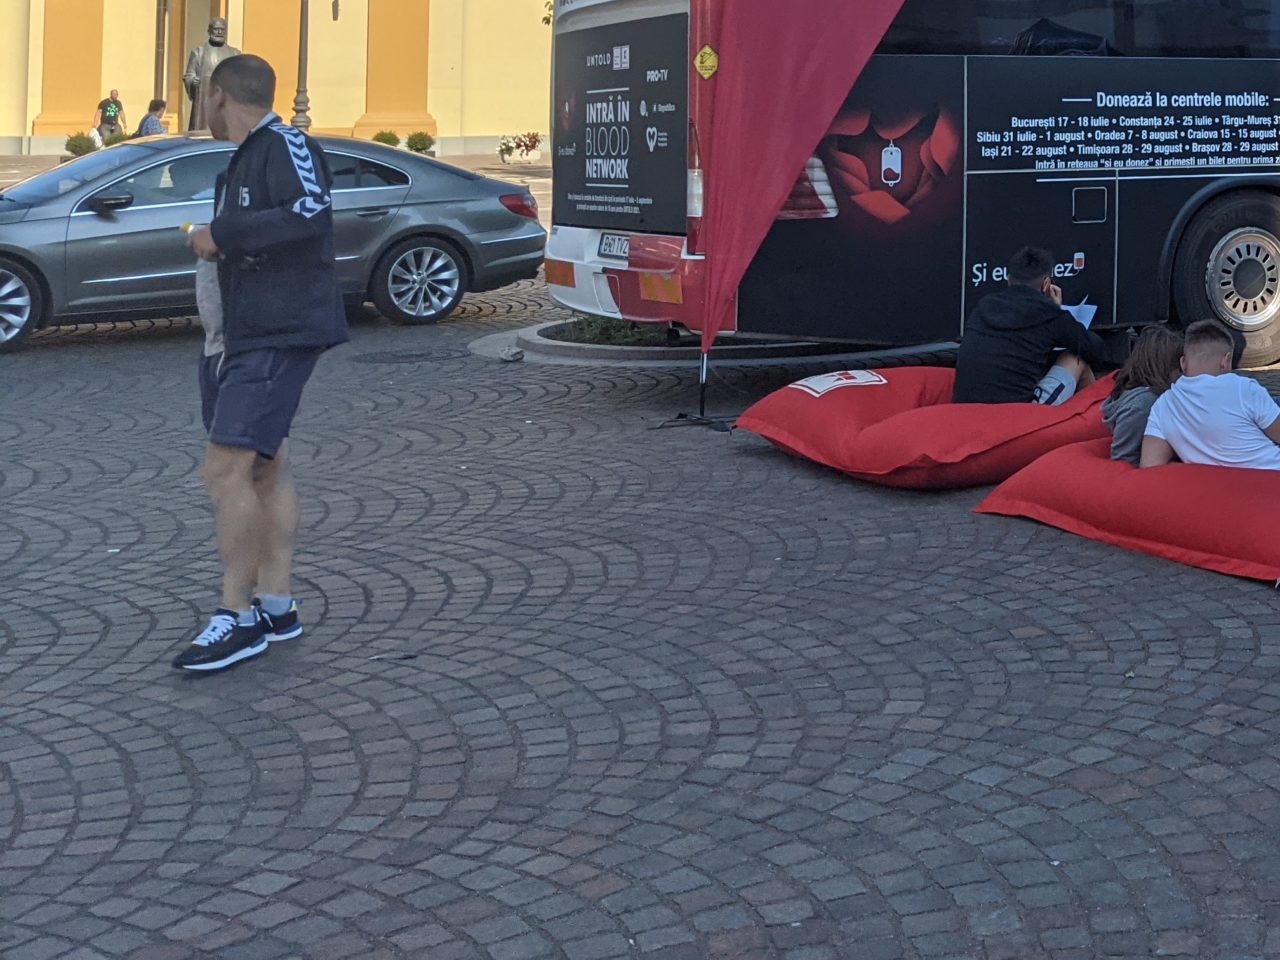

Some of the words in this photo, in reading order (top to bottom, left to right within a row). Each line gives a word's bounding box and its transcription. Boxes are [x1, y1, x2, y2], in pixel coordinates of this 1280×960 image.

[586, 53, 611, 67] UNTOLD
[1097, 91, 1152, 108] Donează
[1156, 92, 1167, 107] la
[1171, 92, 1222, 107] centrele
[1225, 92, 1269, 107] mobile:
[586, 95, 614, 123] INTRĂ
[617, 95, 630, 122] ÎN
[1012, 117, 1055, 129] București
[1058, 117, 1068, 127] 17
[1078, 117, 1088, 126] 18
[1091, 116, 1109, 126] iulie
[1119, 116, 1162, 128] Constanța
[1164, 116, 1174, 126] 24
[1183, 116, 1193, 126] 25
[1195, 116, 1212, 125] iulie
[586, 126, 630, 156] BLOOD
[977, 132, 1000, 142] Sibiu
[1003, 132, 1013, 142] 31
[1017, 131, 1036, 141] iulie
[1046, 131, 1050, 141] 1
[1054, 131, 1085, 143] august
[1095, 130, 1125, 140] Oradea
[1128, 130, 1133, 140] 7
[1142, 130, 1147, 139] 8
[1149, 130, 1178, 140] august
[1187, 129, 1218, 139] Craiova
[1220, 129, 1230, 138] 15
[1238, 129, 1247, 138] 15
[1250, 128, 1276, 140] august
[982, 146, 998, 159] Iași
[1001, 146, 1011, 156] 21
[1022, 146, 1033, 156] 22
[1036, 146, 1067, 157] august
[1077, 144, 1120, 156] Timișoara
[1122, 144, 1132, 154] 28
[1141, 144, 1151, 153] 29
[1154, 143, 1182, 154] august
[1192, 143, 1220, 154] Brașov
[1222, 143, 1232, 152] 28
[1240, 142, 1250, 151] 29
[1252, 142, 1279, 153] august
[586, 159, 629, 179] NETWORK
[1036, 159, 1055, 169] Intră
[1208, 156, 1225, 165] bilet
[1227, 156, 1250, 165] pentru
[1252, 155, 1273, 164] prima
[972, 262, 987, 287] Și
